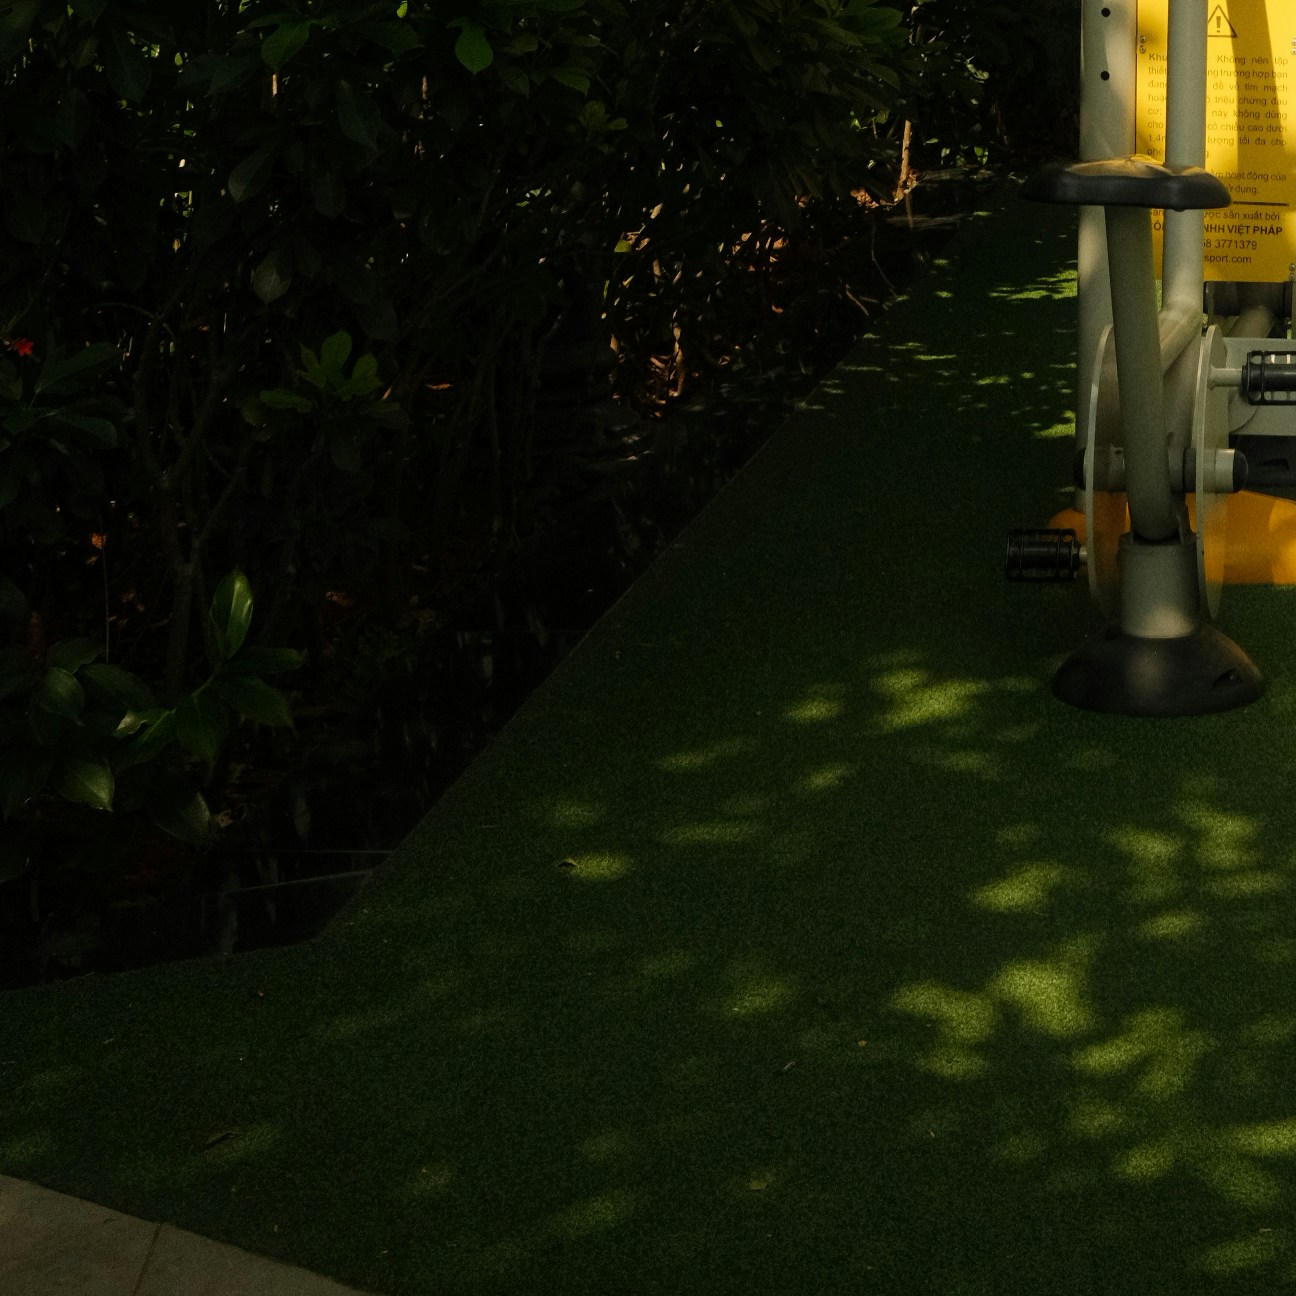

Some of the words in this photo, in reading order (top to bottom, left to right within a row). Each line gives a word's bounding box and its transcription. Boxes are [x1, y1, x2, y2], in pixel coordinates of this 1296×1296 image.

[1217, 55, 1246, 66] Không
[1233, 110, 1260, 121] không
[1226, 224, 1251, 237] VIỆT
[1253, 224, 1283, 237] PHÁP
[1215, 238, 1258, 250] 3771379
